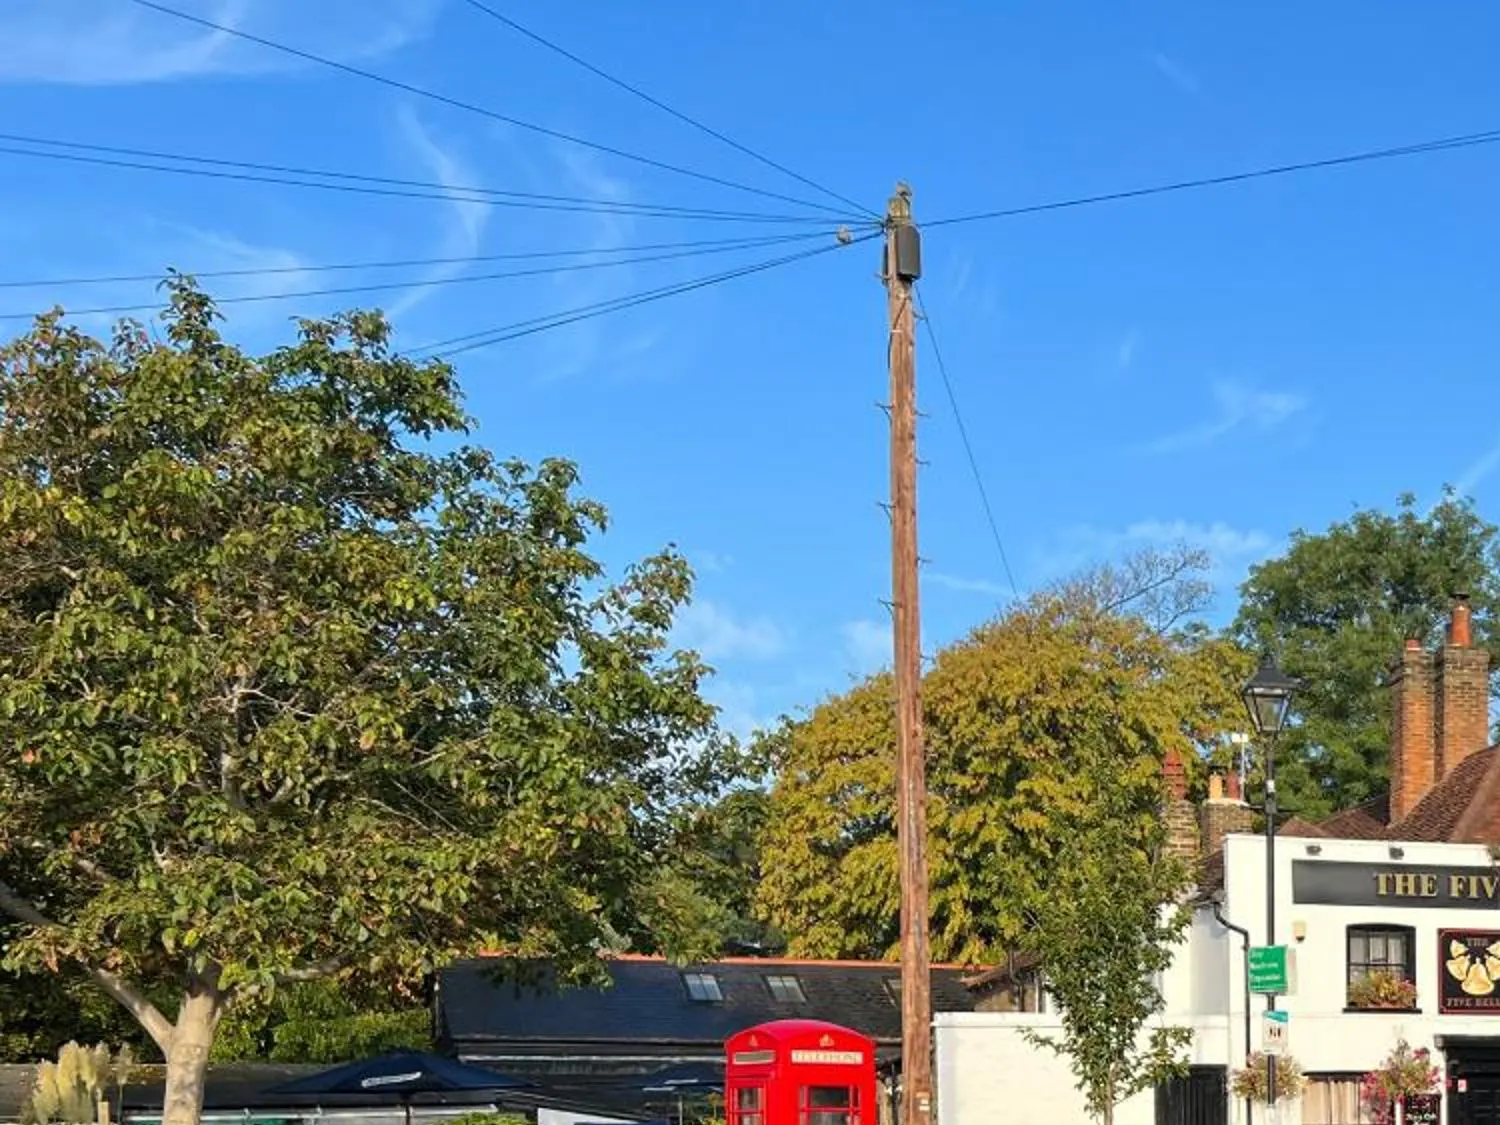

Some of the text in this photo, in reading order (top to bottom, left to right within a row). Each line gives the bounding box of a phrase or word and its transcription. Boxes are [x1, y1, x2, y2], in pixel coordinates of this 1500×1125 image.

[1373, 872, 1438, 897] THE
[1467, 938, 1488, 947] THE
[1447, 998, 1471, 1007] FIVE
